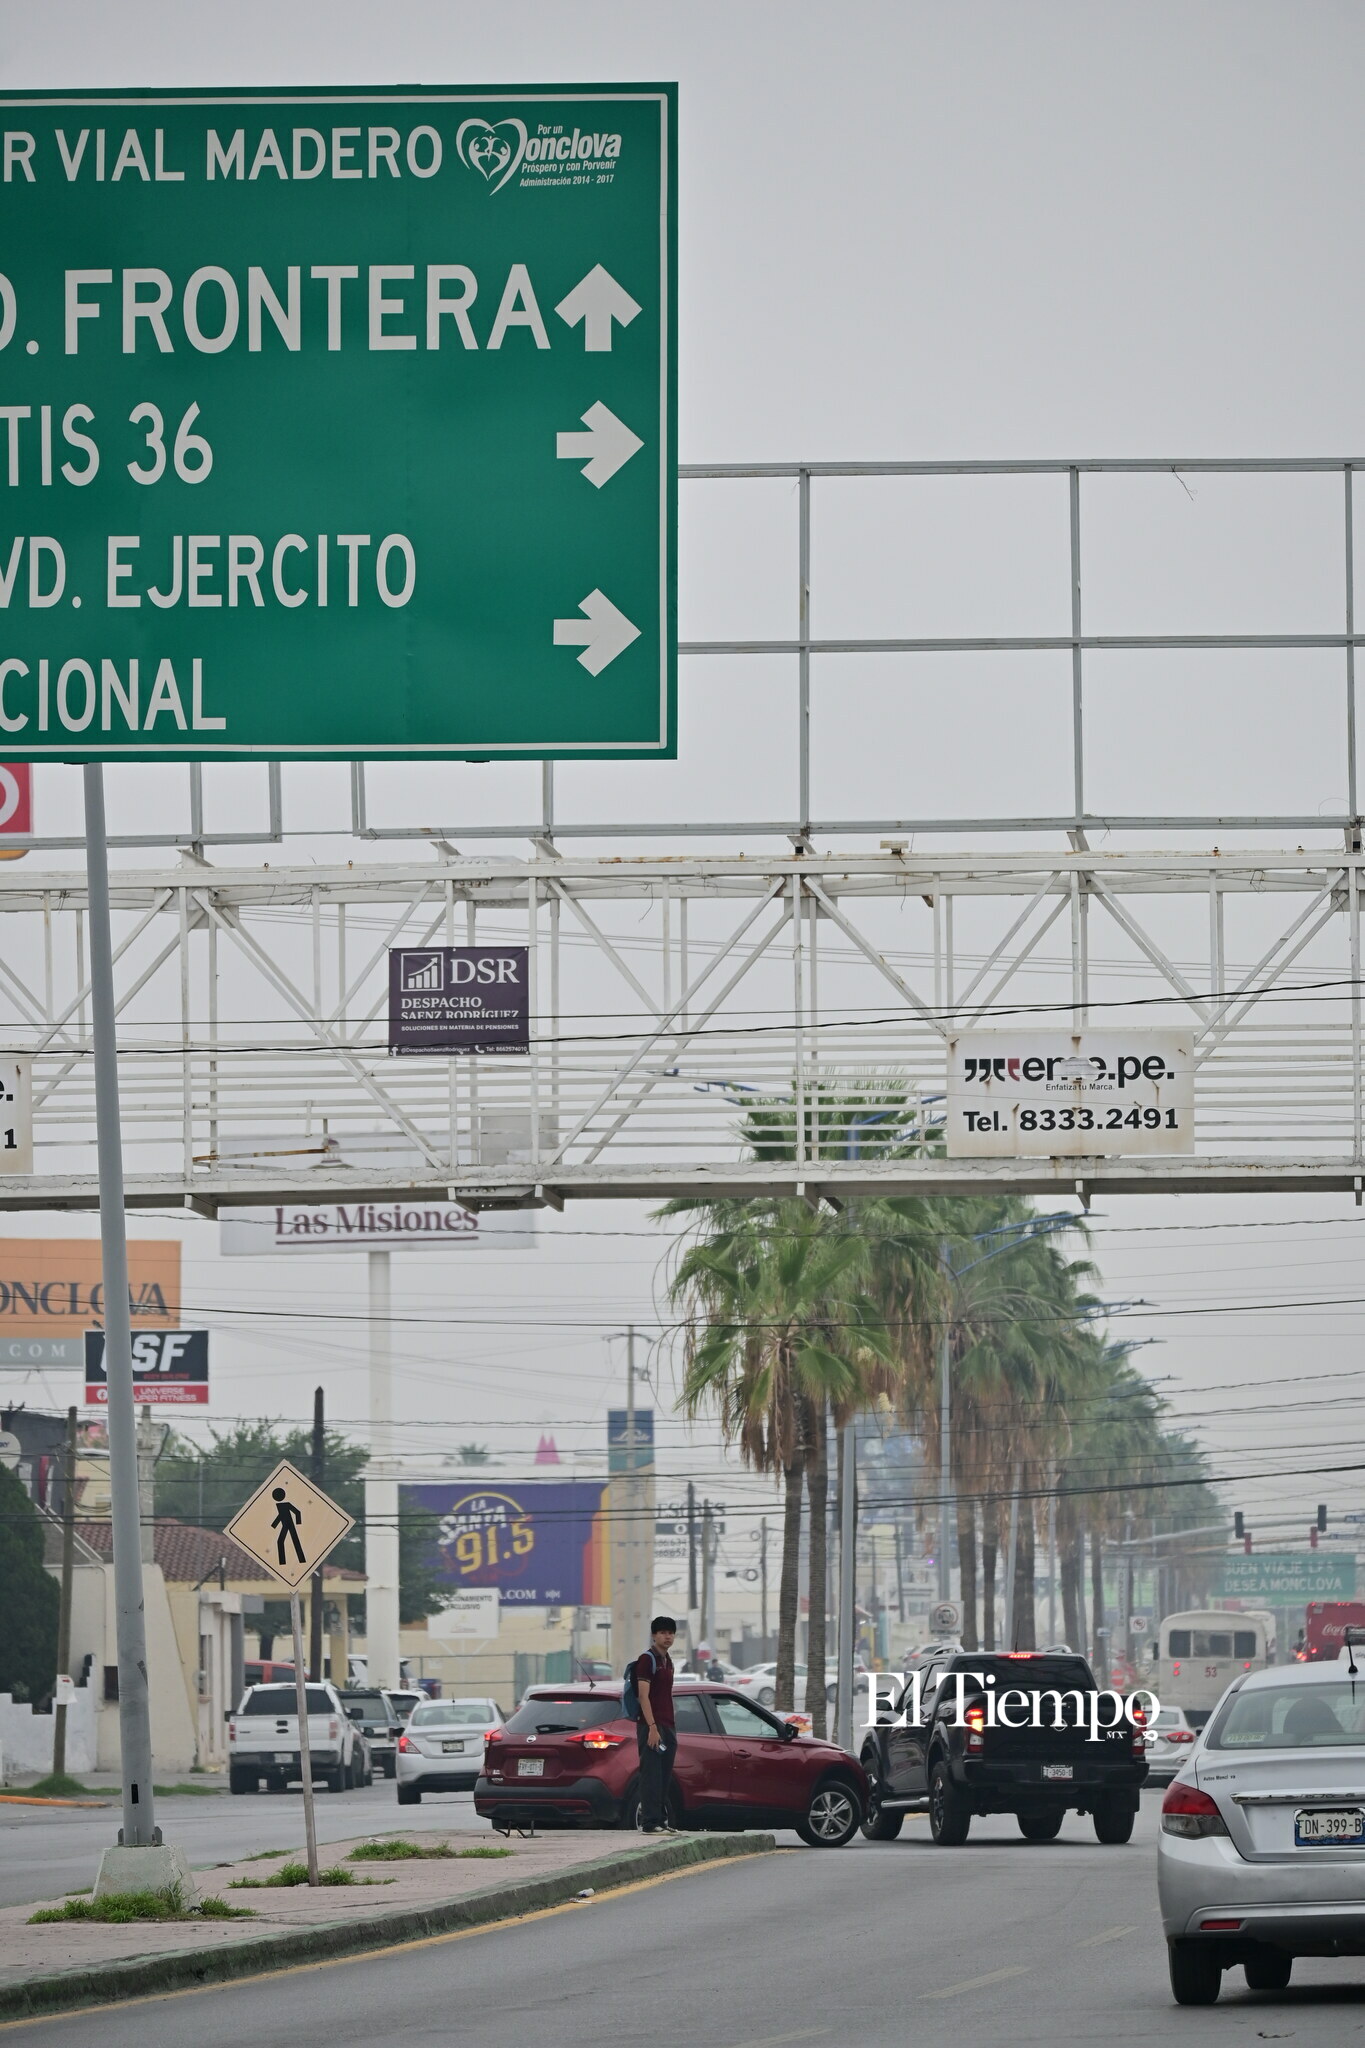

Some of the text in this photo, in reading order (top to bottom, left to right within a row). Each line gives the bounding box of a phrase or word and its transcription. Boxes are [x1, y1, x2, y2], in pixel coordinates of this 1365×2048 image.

[537, 124, 564, 135] Por un
[56, 127, 184, 183] VIAL
[206, 125, 443, 182] MADERO
[521, 159, 616, 174] Próspero y con Porvenir
[519, 175, 571, 187] Administración
[572, 175, 590, 185] 2014
[597, 174, 615, 184] 2017
[64, 263, 551, 355] FRONTERA
[126, 400, 213, 486] 36
[107, 533, 417, 609] EJERCITO
[0, 657, 227, 733] CIONAL
[449, 958, 520, 984] DSR
[401, 997, 482, 1009] DESPACHO
[401, 1010, 442, 1020] SAENZ
[1045, 1083, 1077, 1091] Enfatiza
[1089, 1083, 1115, 1091] Marca.
[963, 1108, 1179, 1132] Tel. 8333.2491
[275, 1205, 479, 1236] Las Misiones
[471, 1499, 486, 1512] LA
[438, 1505, 507, 1545] SANTA
[456, 1516, 535, 1575] 91.5
[1270, 1577, 1343, 1591] MONCLOVA
[1205, 1666, 1217, 1678] 53
